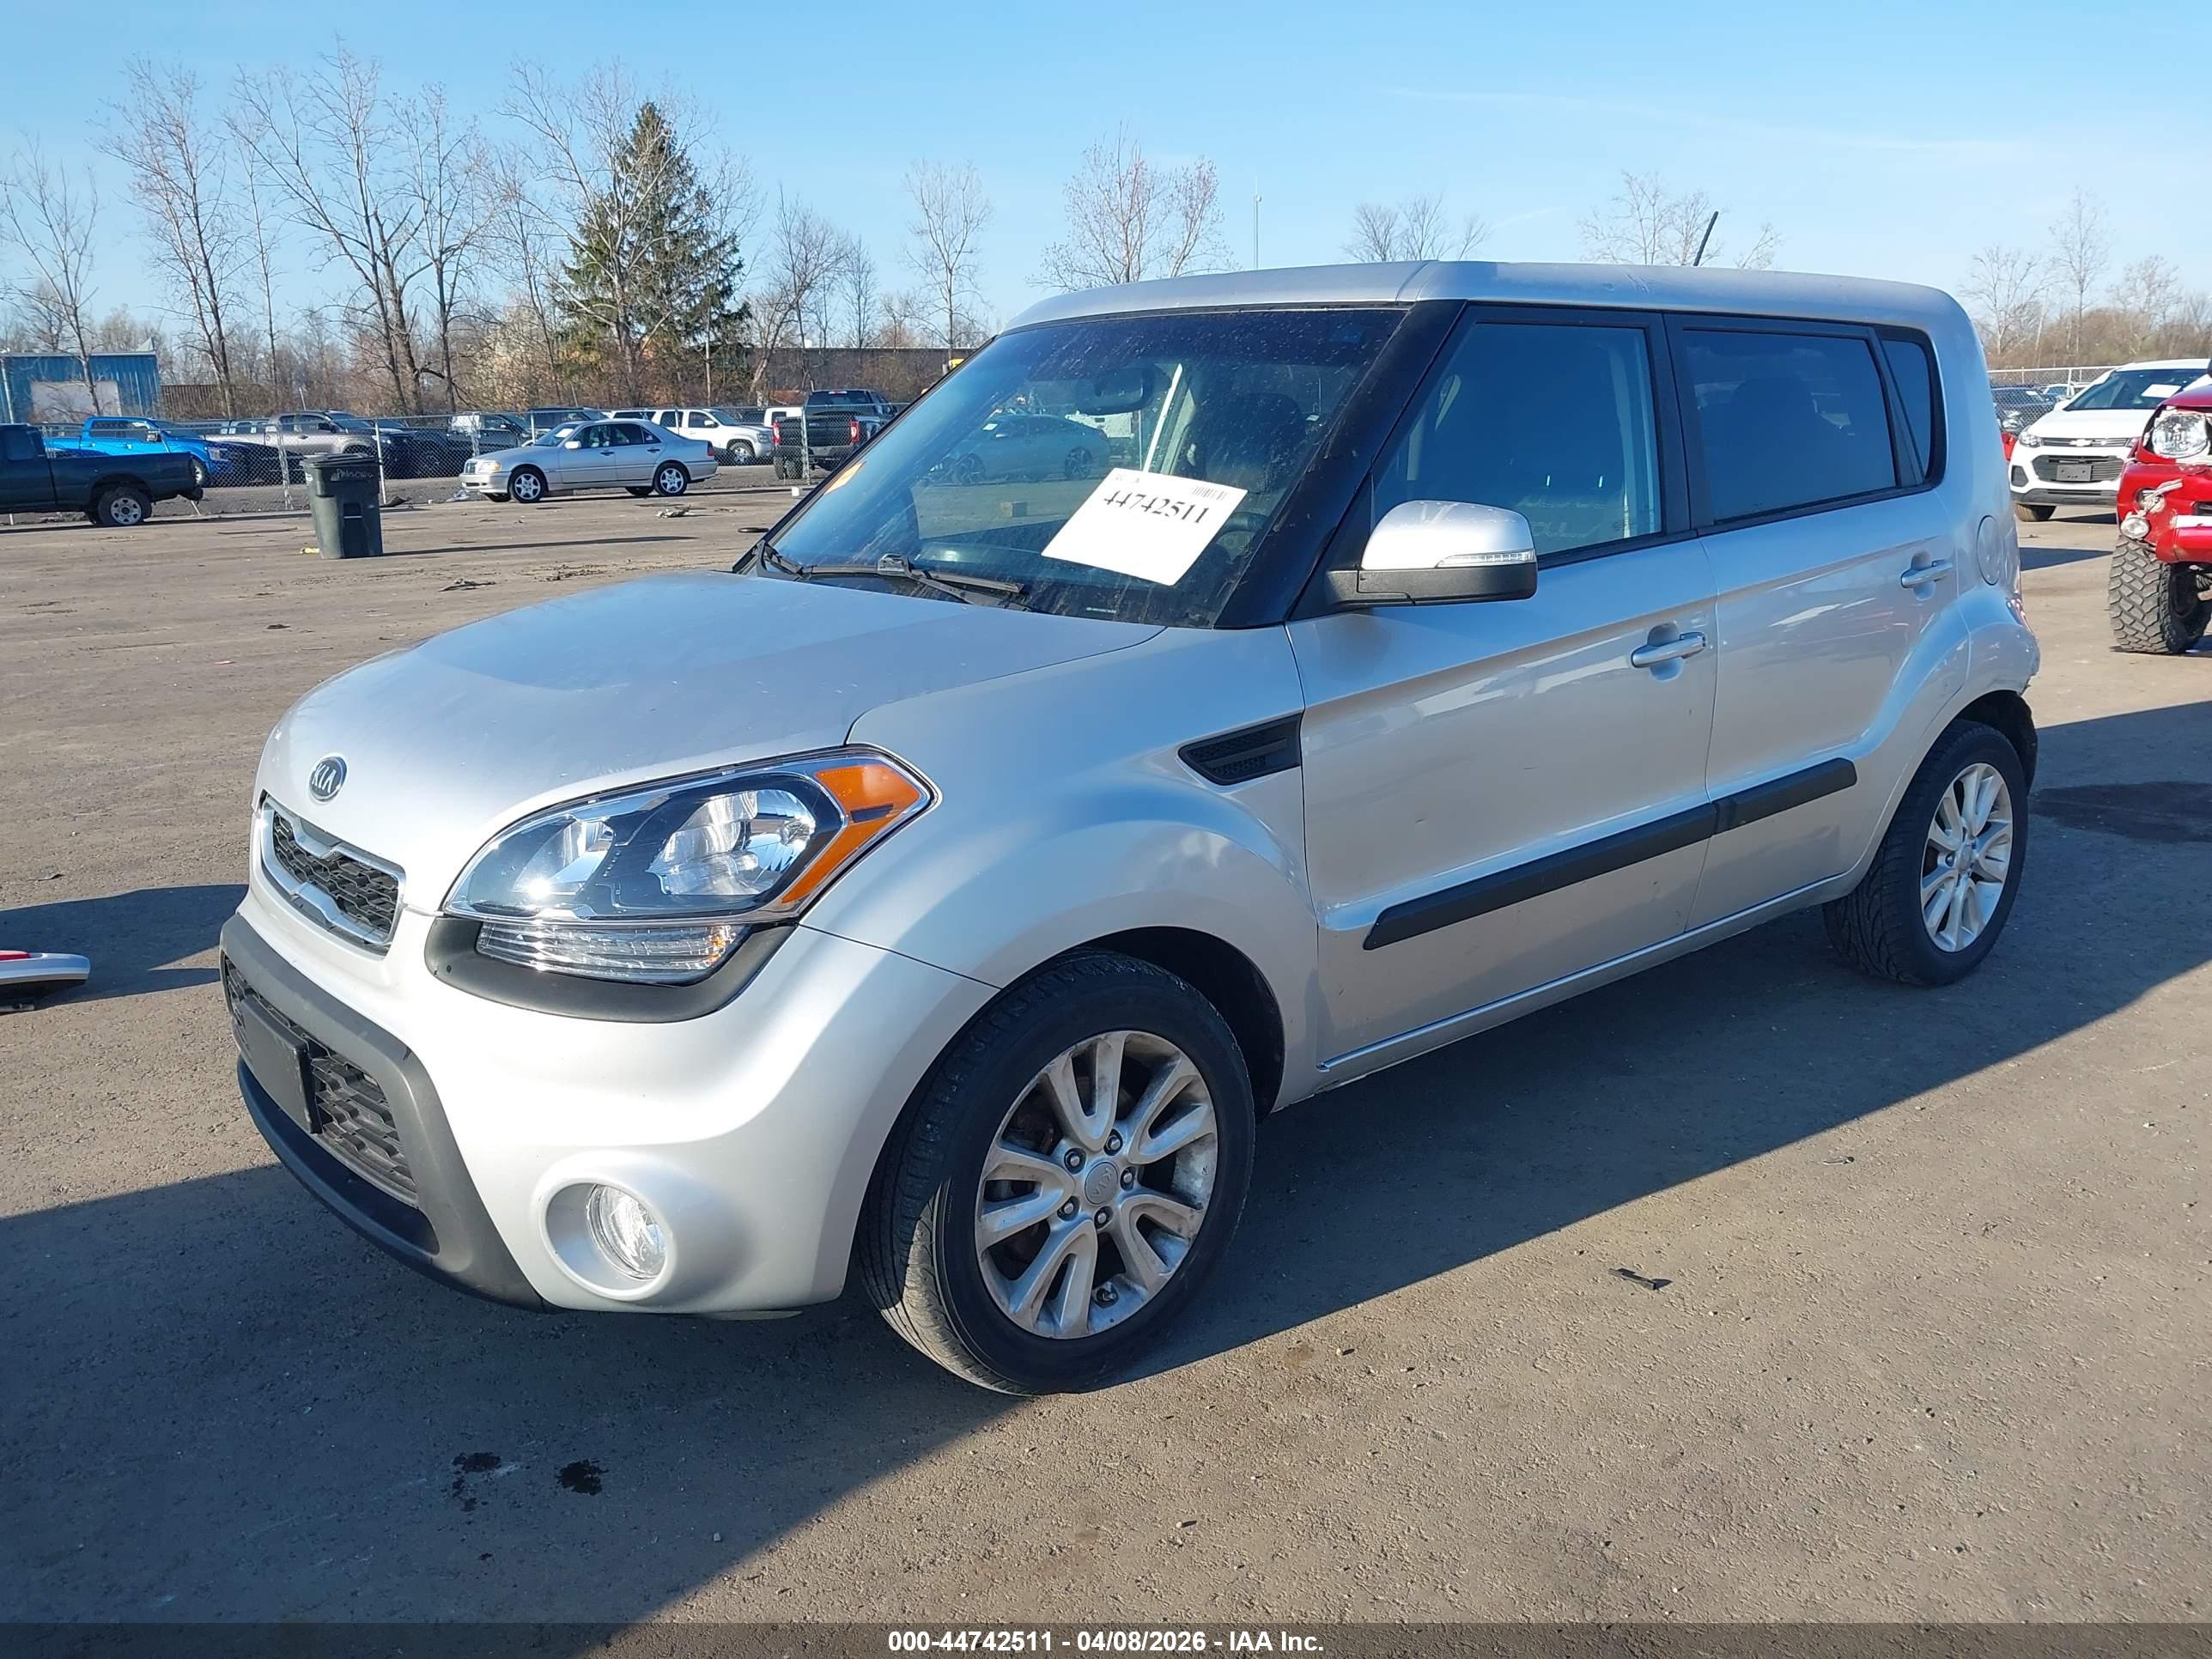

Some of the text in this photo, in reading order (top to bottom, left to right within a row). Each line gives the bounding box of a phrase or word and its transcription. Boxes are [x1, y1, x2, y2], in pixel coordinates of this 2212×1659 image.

[1103, 489, 1209, 524] 44742511
[311, 763, 337, 794] KIA
[1091, 1167, 1114, 1195] KIA
